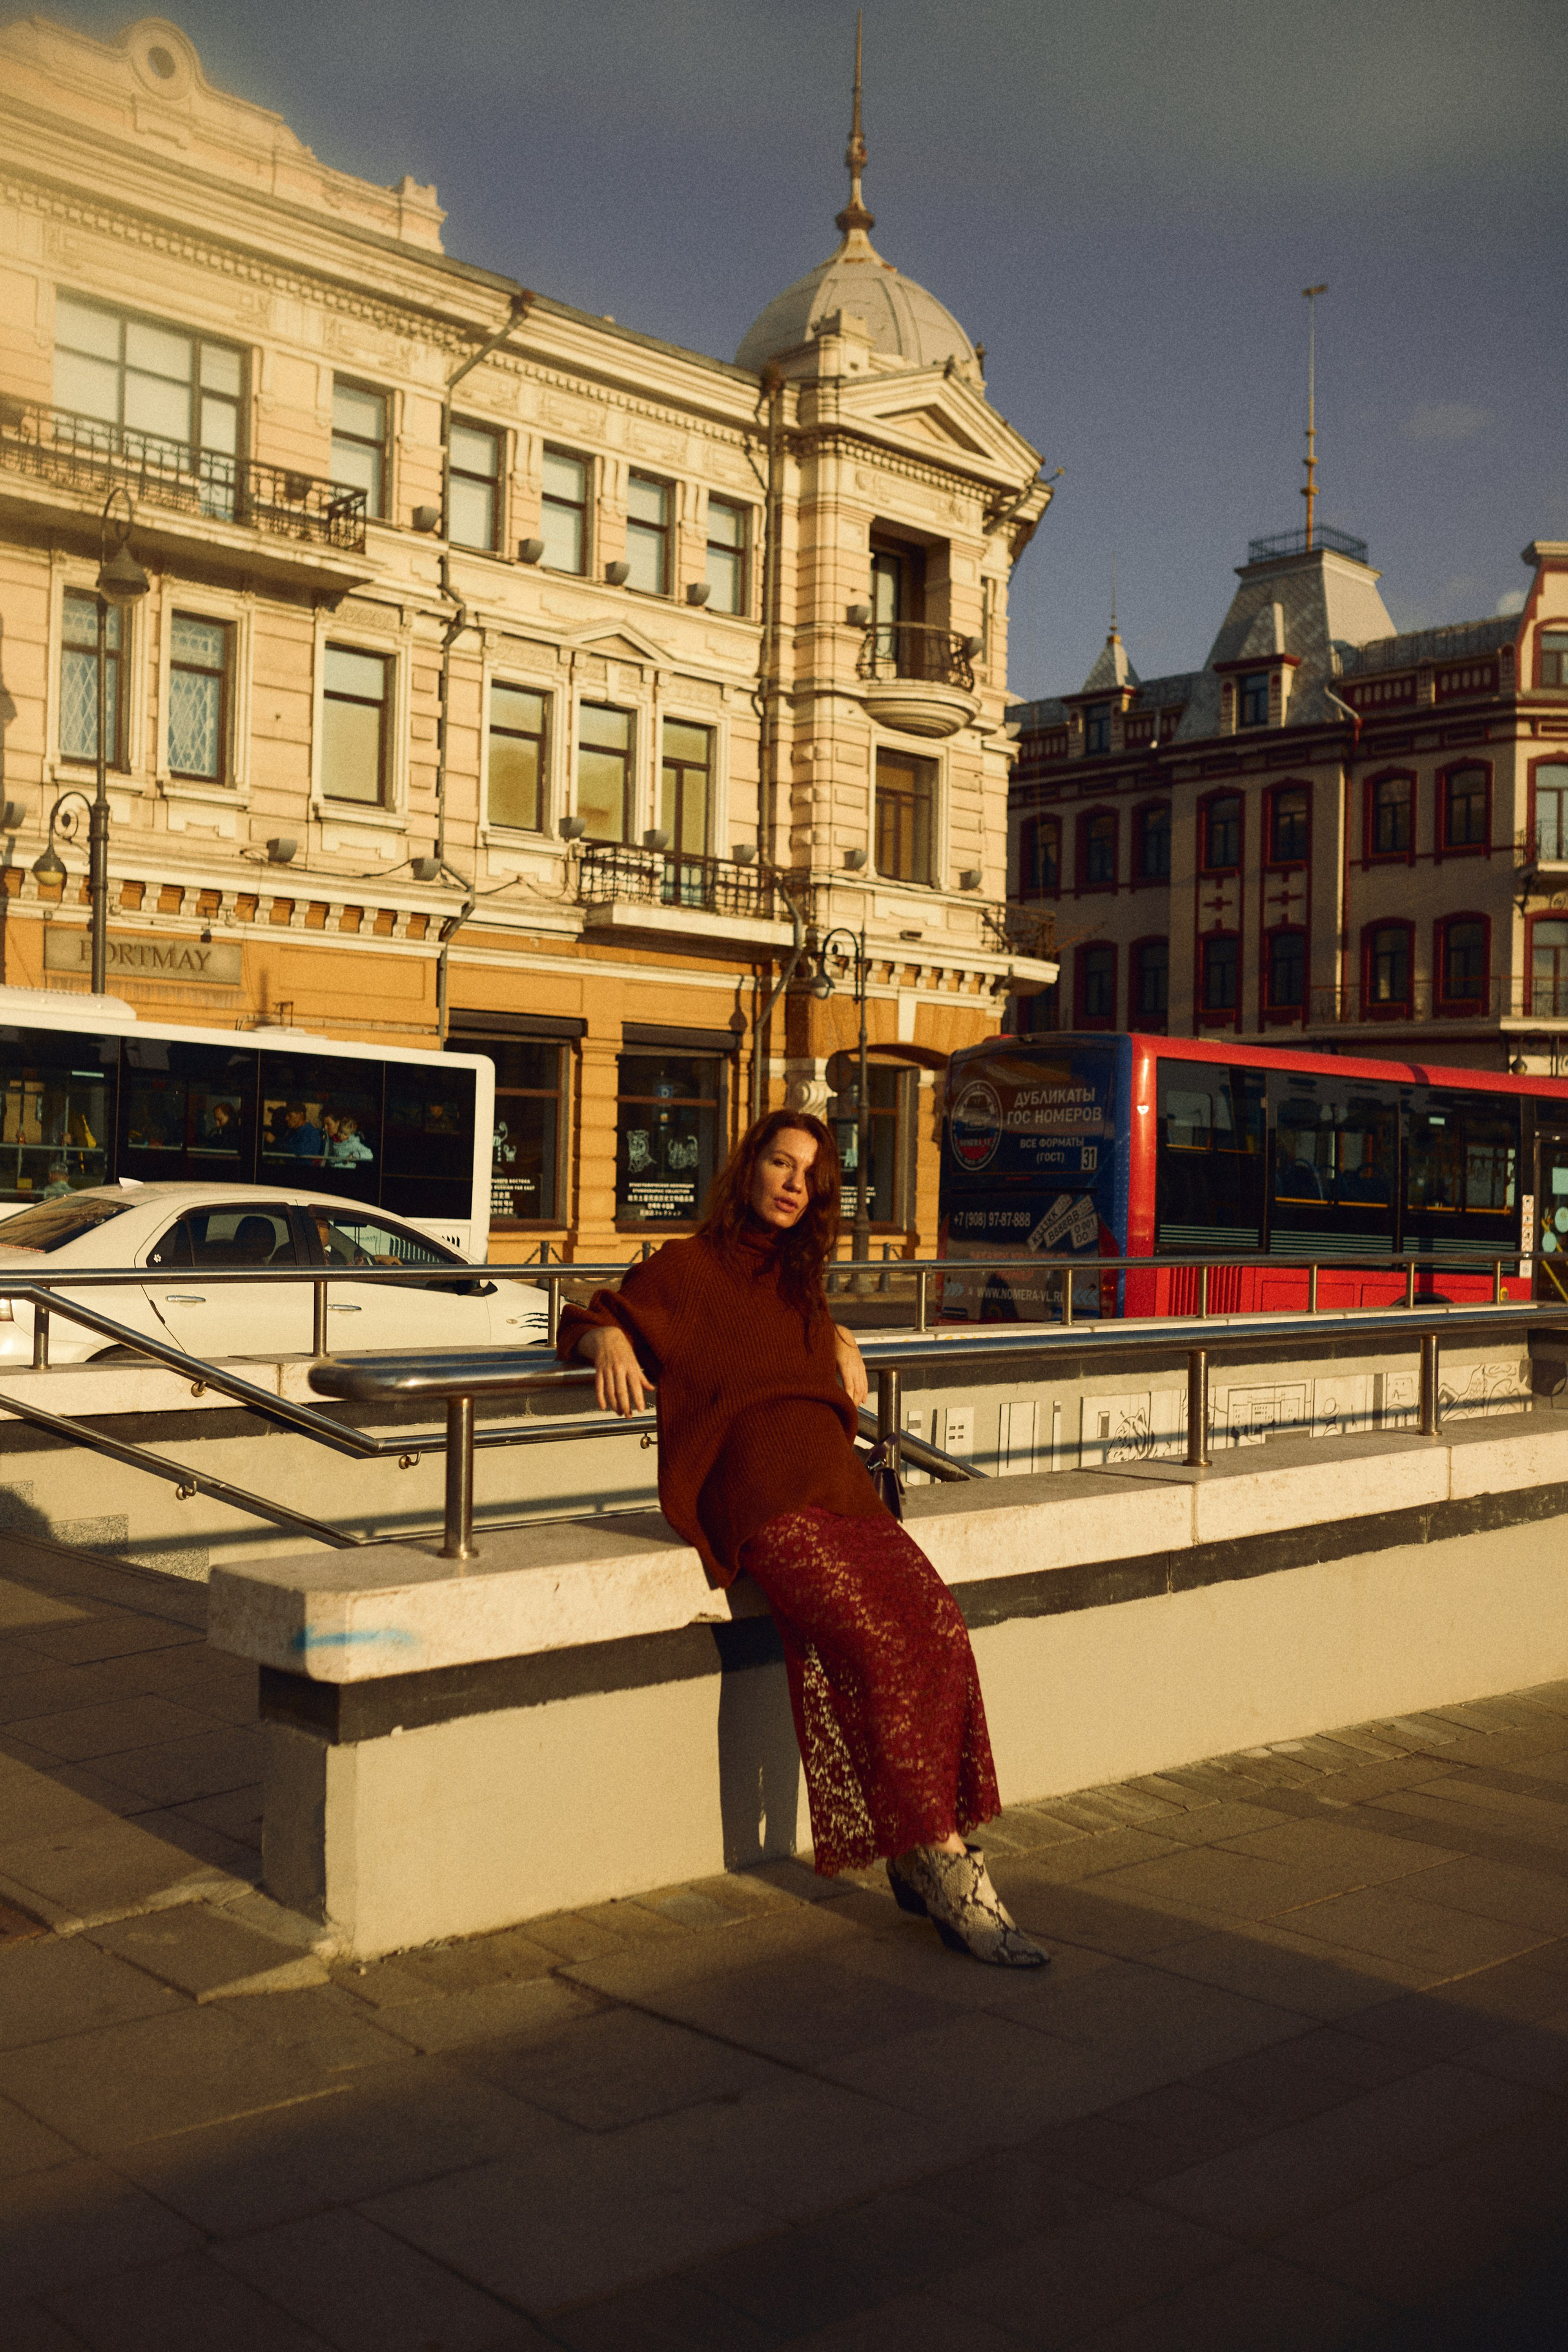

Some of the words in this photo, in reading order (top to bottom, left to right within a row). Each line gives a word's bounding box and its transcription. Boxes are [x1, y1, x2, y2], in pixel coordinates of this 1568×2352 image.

[1014, 1087, 1096, 1108] ДУБЛИКАТЫ
[1006, 1110, 1031, 1125] ГОС
[1035, 1106, 1102, 1124] НОМЕРОВ
[1020, 1138, 1037, 1148] ВСЕ
[1039, 1137, 1085, 1148] ФОРМАТЫ
[1036, 1152, 1065, 1164] (ГОСТ)
[1084, 1148, 1095, 1169] 31
[954, 1212, 964, 1226] +7
[988, 1212, 1031, 1226] 97-87-888
